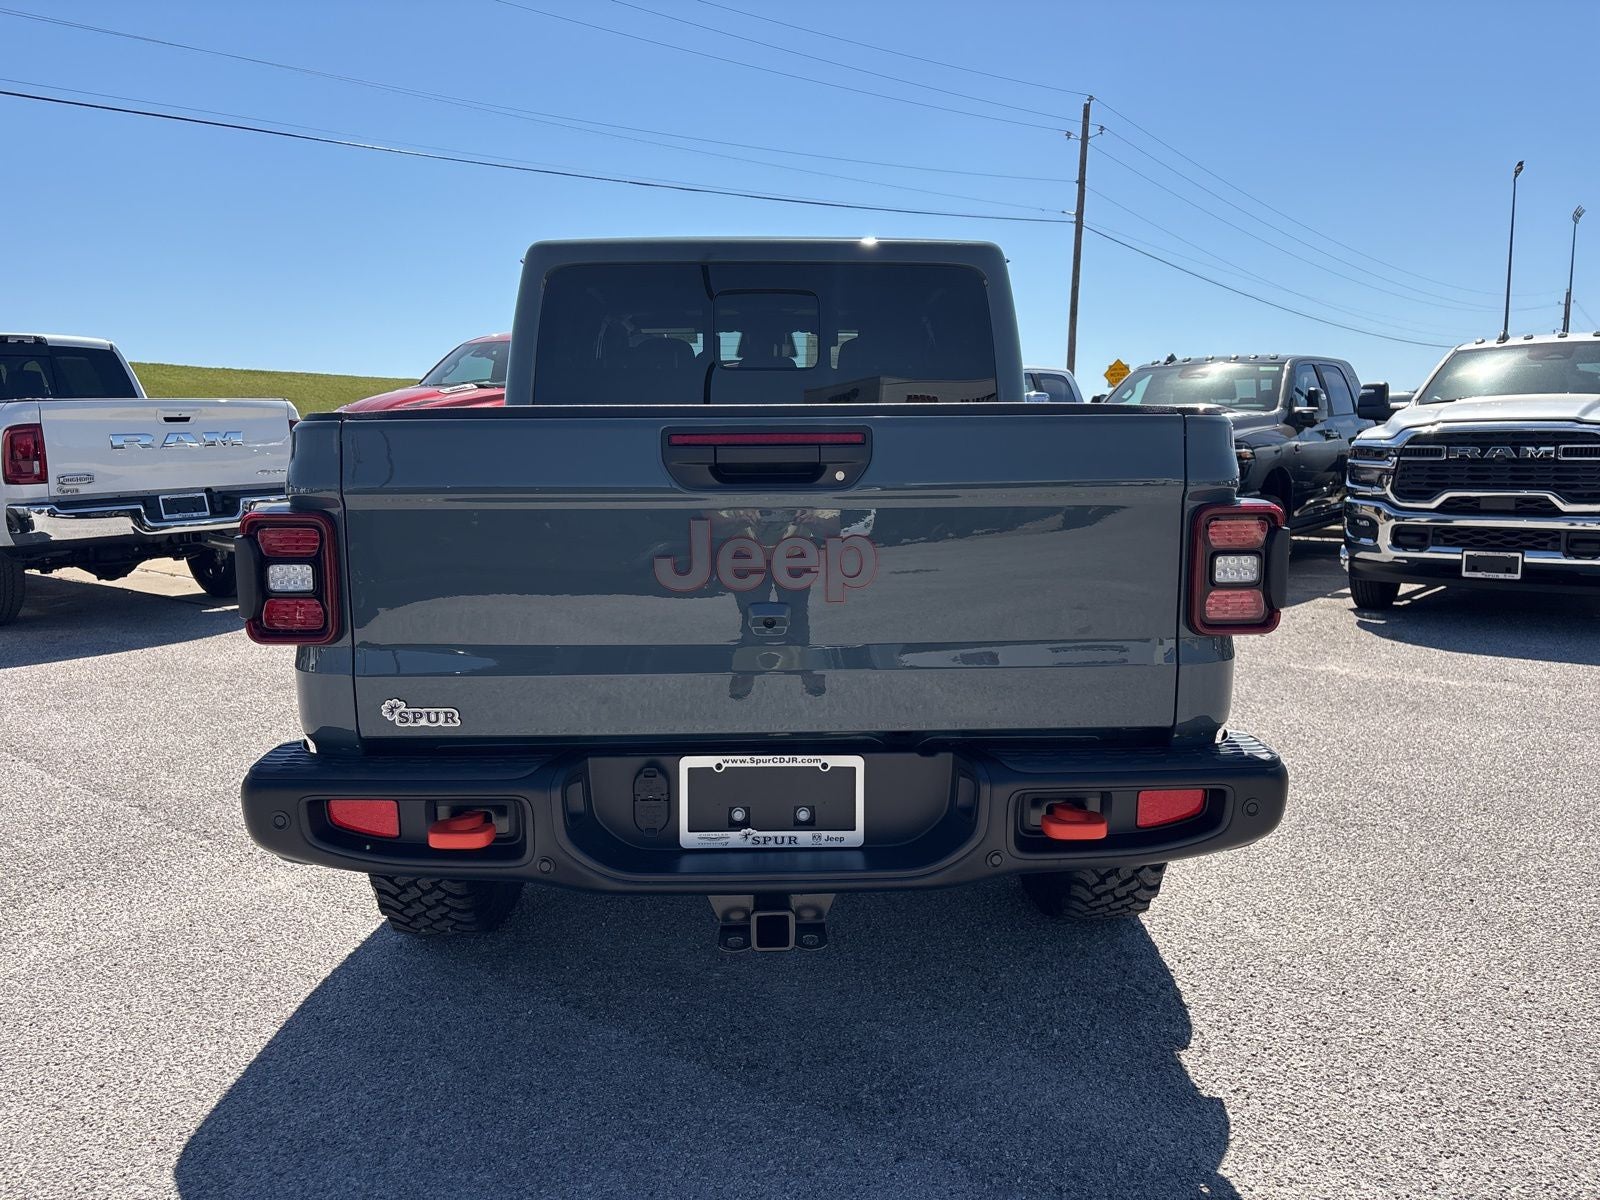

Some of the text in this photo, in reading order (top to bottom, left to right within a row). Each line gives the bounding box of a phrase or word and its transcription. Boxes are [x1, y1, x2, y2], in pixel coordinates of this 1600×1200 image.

[109, 431, 243, 450] RAM
[1448, 446, 1556, 459] RAM
[653, 517, 878, 603] Jeep
[398, 711, 457, 724] SPUR
[722, 756, 822, 766] www.SpurCDJR.com
[752, 835, 799, 845] SPUR
[824, 835, 845, 843] Jeep
